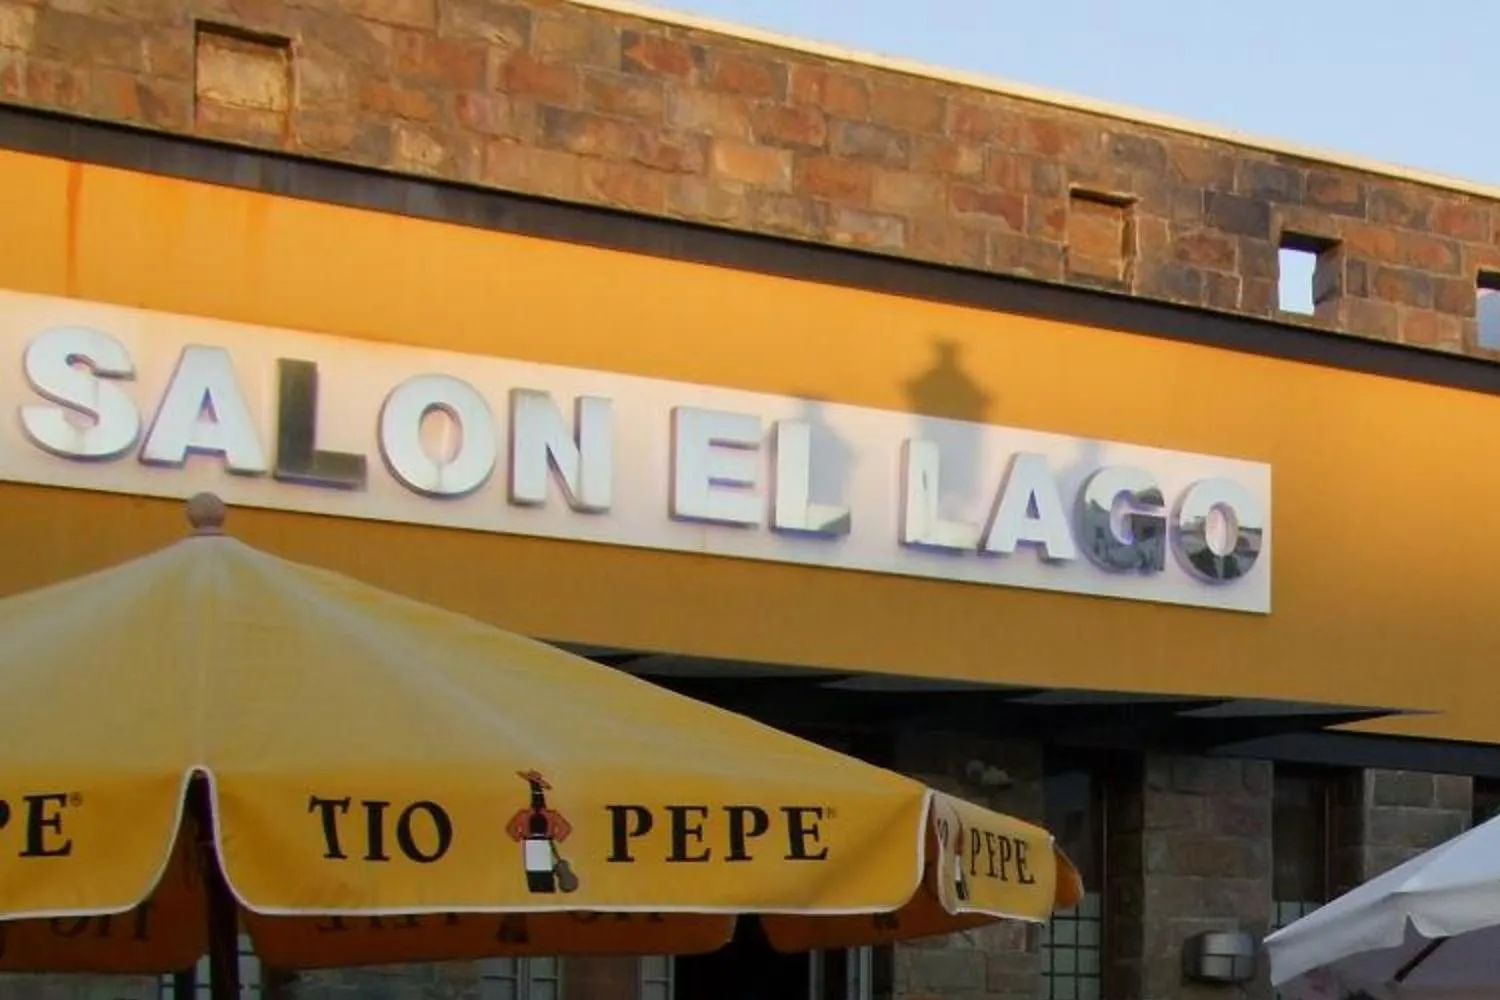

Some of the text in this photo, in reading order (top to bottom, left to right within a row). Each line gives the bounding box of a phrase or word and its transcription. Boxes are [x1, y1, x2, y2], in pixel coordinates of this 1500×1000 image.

[19, 324, 1264, 585] SALON EL LAGO
[308, 795, 829, 863] TIO PEPE
[970, 827, 1036, 885] PEPE
